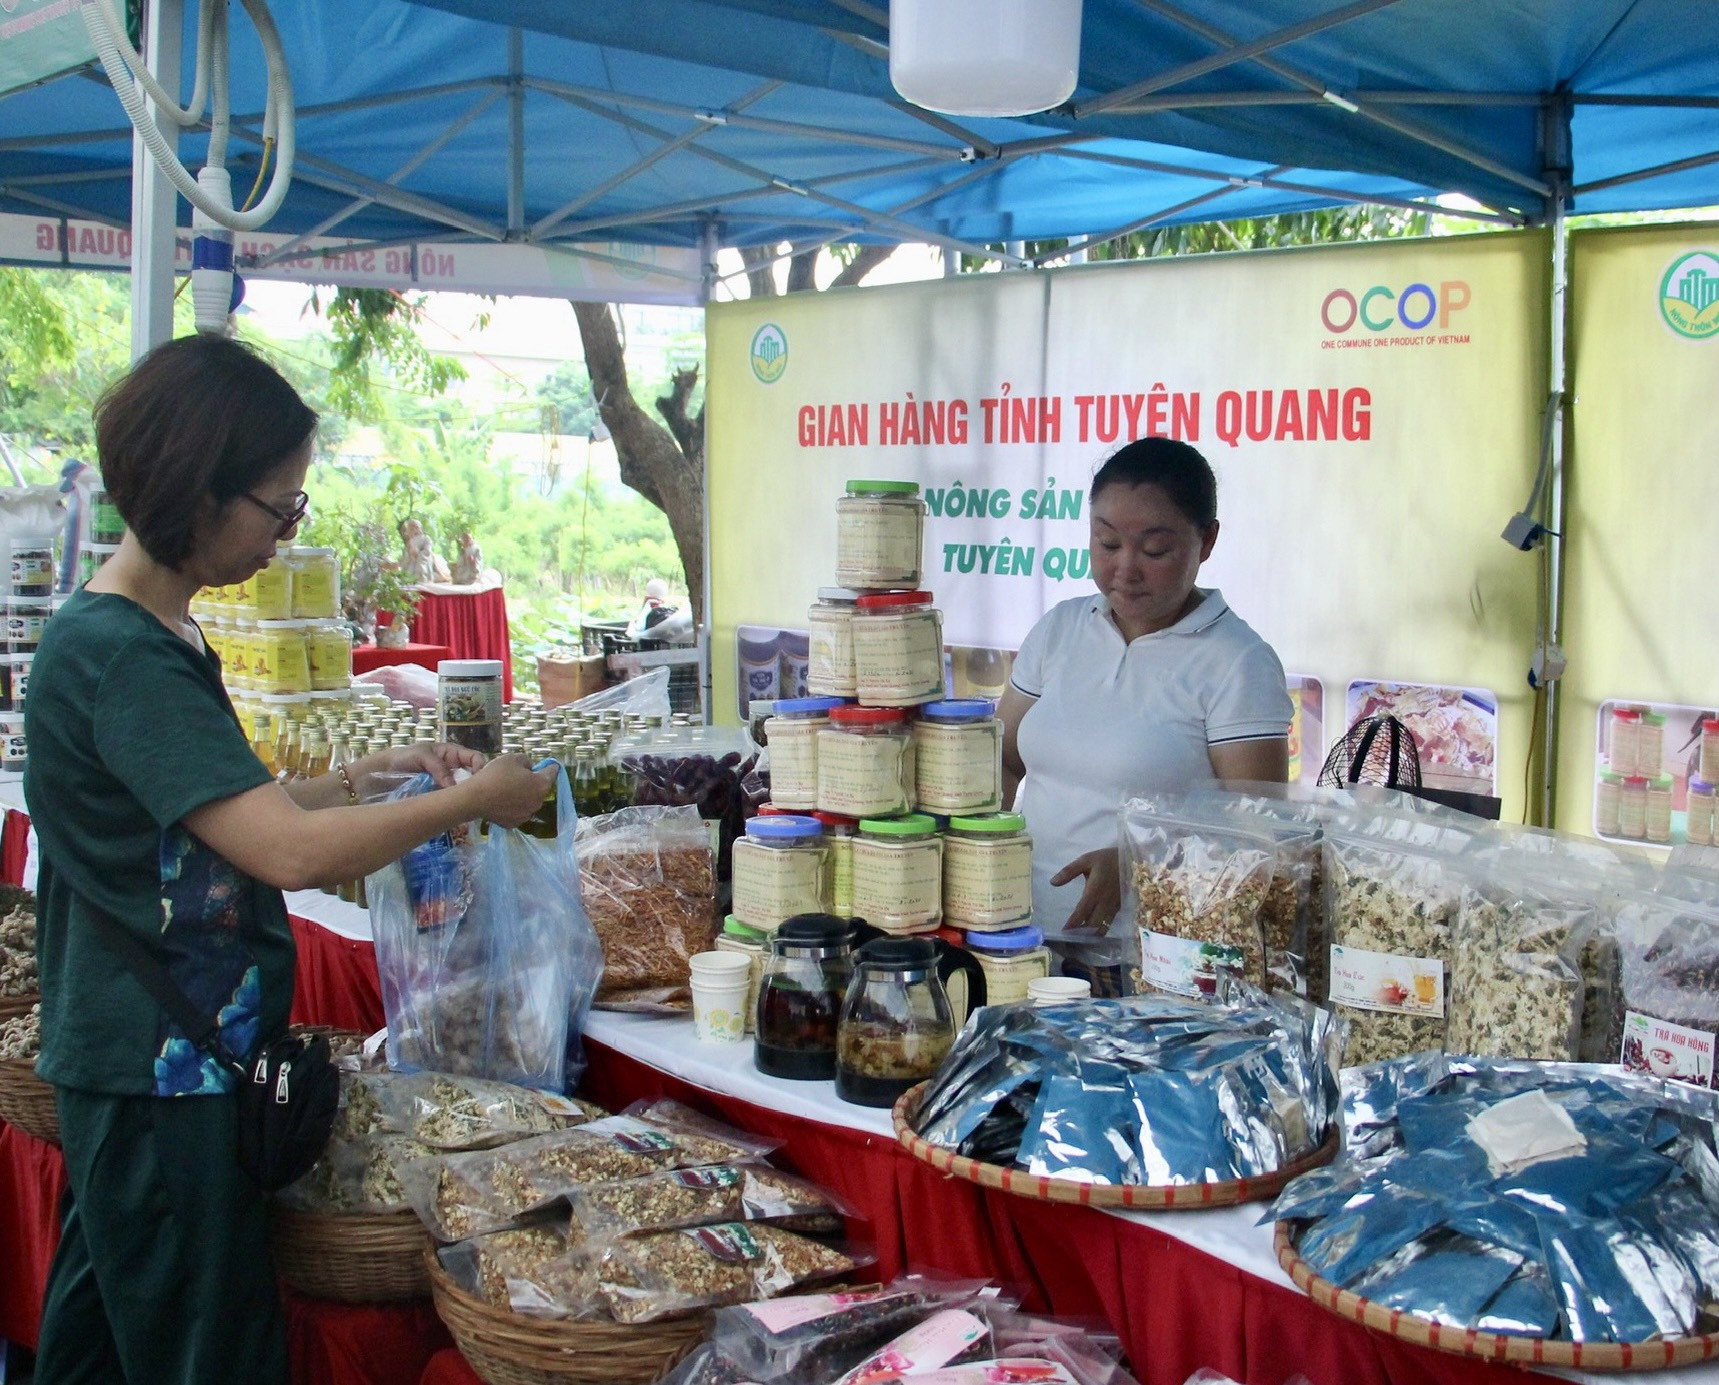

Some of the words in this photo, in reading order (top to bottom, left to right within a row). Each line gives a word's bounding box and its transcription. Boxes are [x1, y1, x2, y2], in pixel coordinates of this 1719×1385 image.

[1321, 280, 1472, 334] OCOP
[1321, 339, 1335, 349] ONE
[1337, 337, 1372, 348] COMMUNE
[1374, 337, 1389, 347] ONE
[1390, 336, 1425, 346] PRODUCT
[1427, 336, 1437, 345] OF
[1438, 334, 1471, 345] VIETNAM
[798, 404, 868, 447] GIAN
[880, 392, 968, 445] HÀNG
[980, 382, 1062, 445] TỈNH
[1073, 383, 1200, 442] TUYÊN
[1215, 387, 1372, 447] QUANG
[926, 480, 1011, 519] NÔNG
[1019, 477, 1082, 520] SẢN
[943, 537, 1034, 577] TUYÊN
